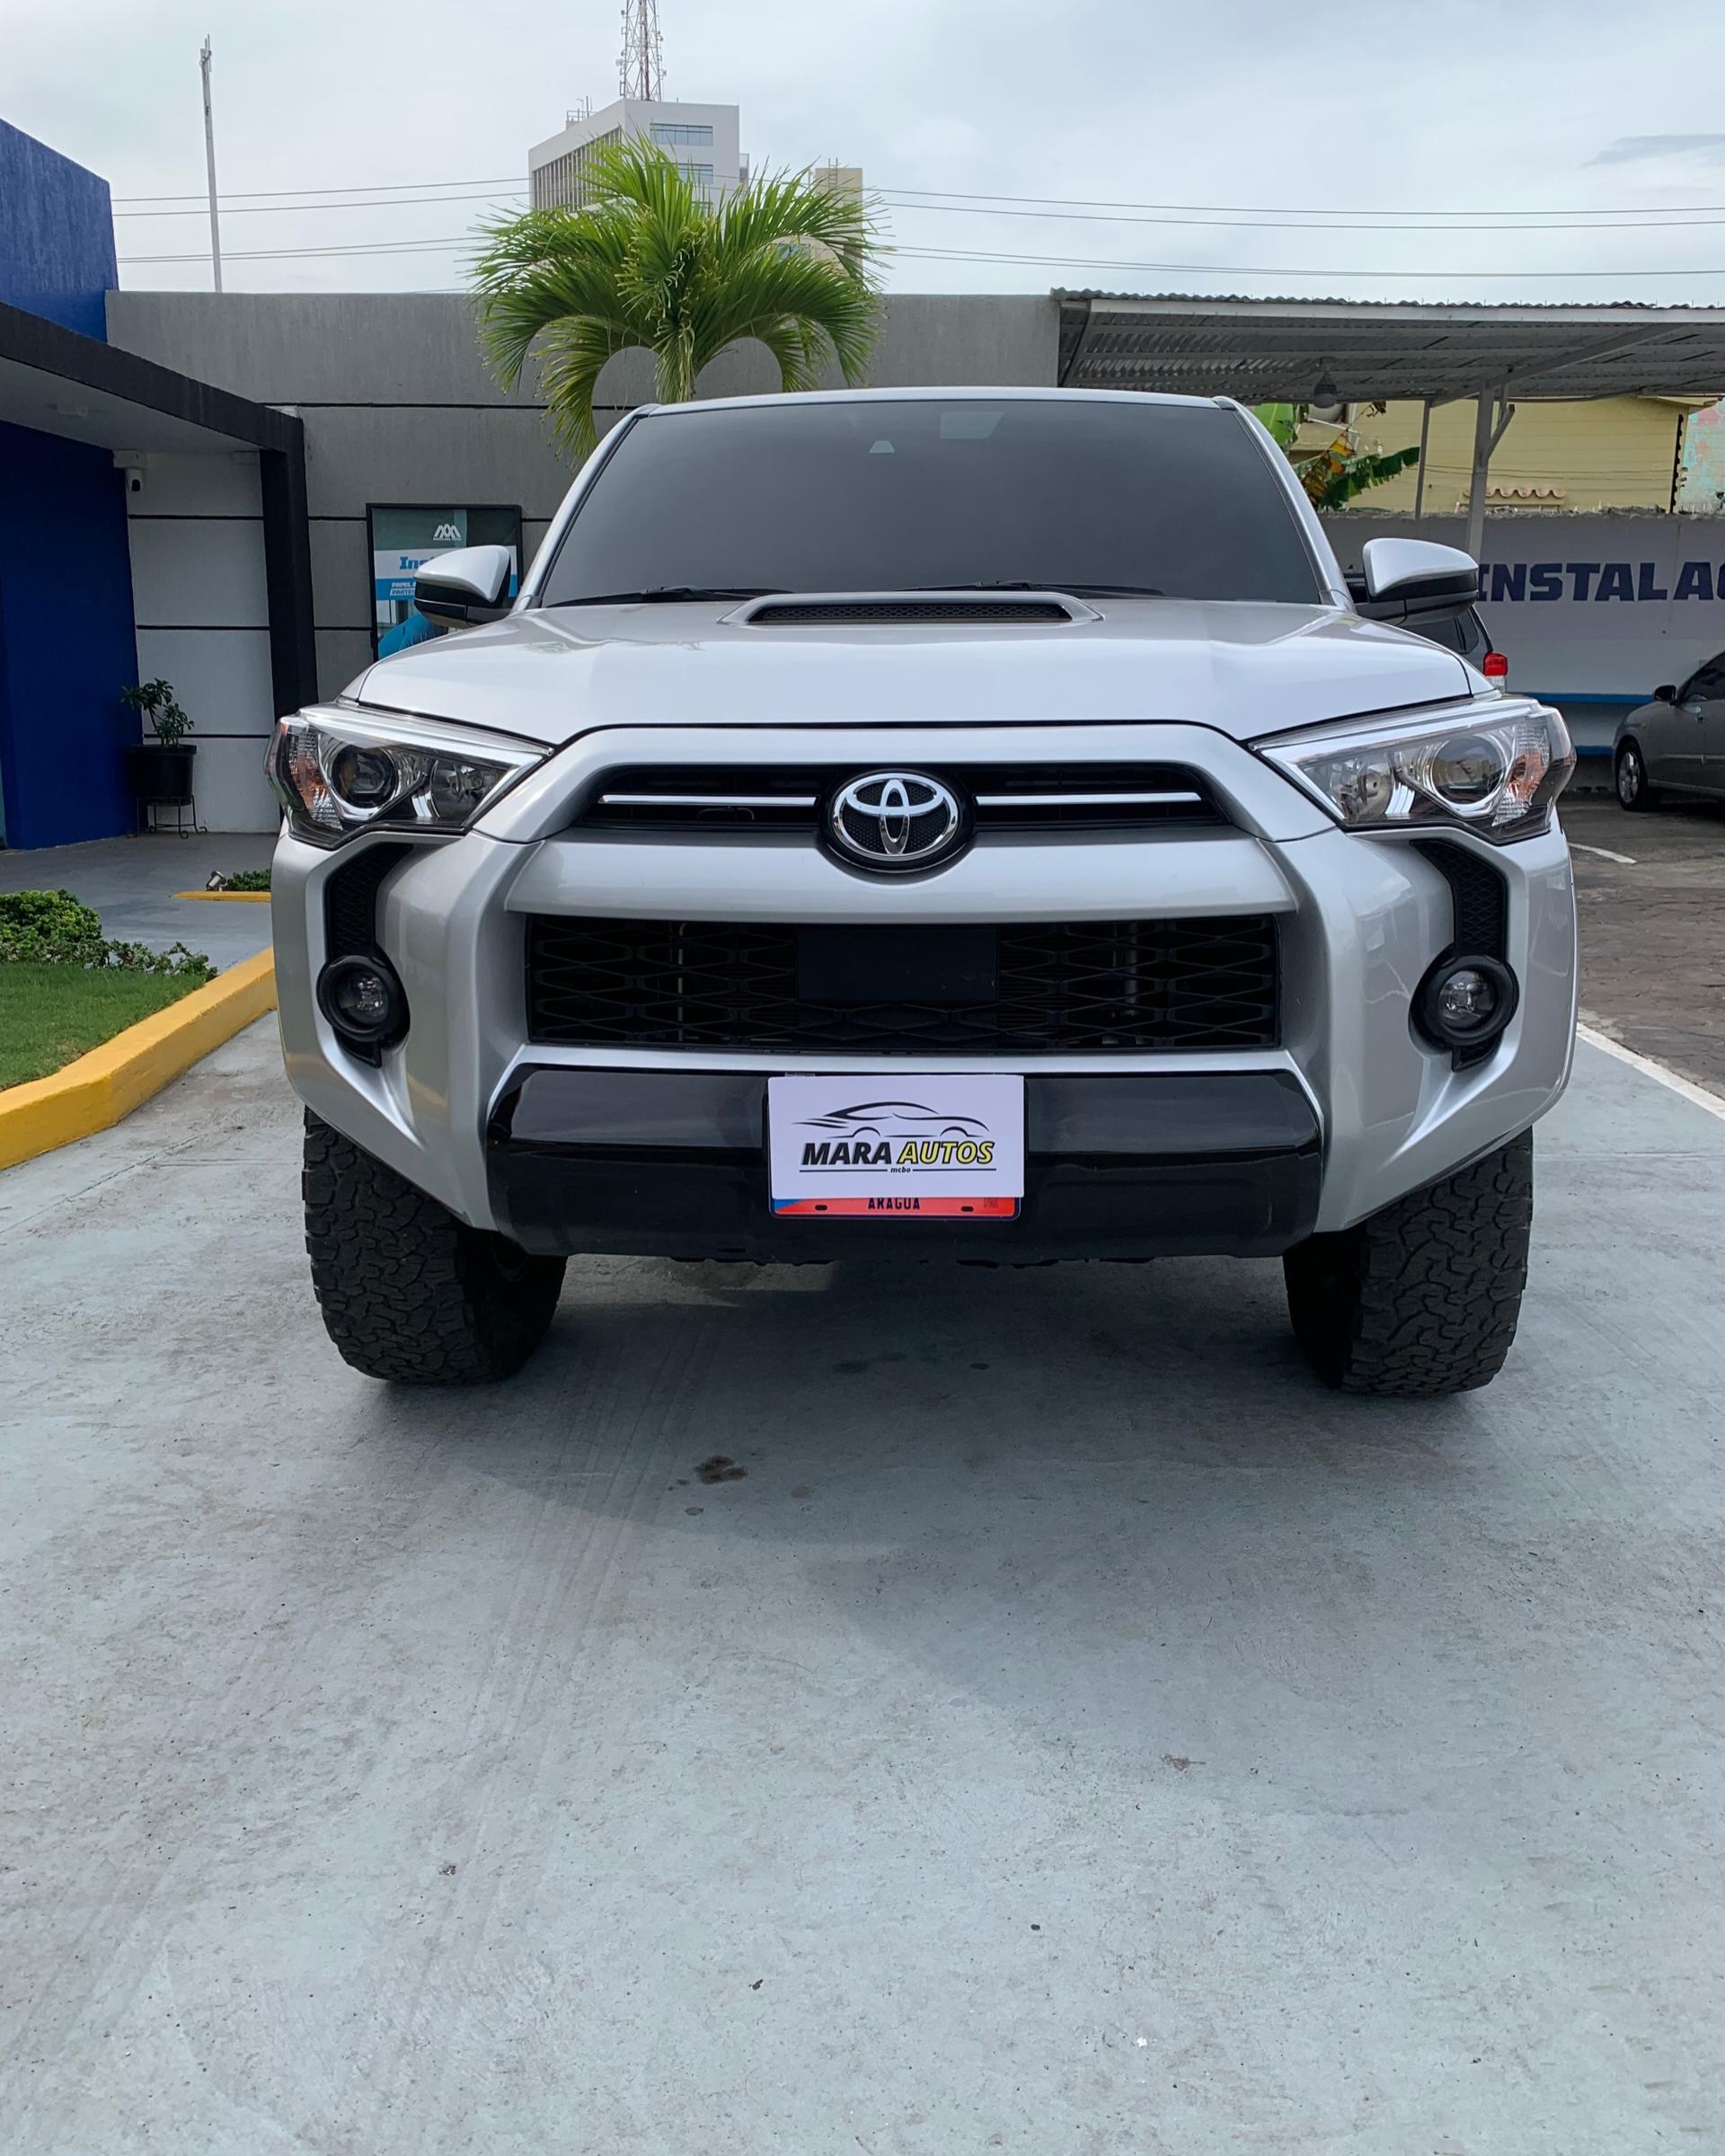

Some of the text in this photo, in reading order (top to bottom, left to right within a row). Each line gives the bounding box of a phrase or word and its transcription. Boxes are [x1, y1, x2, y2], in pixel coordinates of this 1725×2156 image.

[801, 1141, 995, 1165] MARA AUTOS
[868, 1197, 920, 1210] ARAGUA
